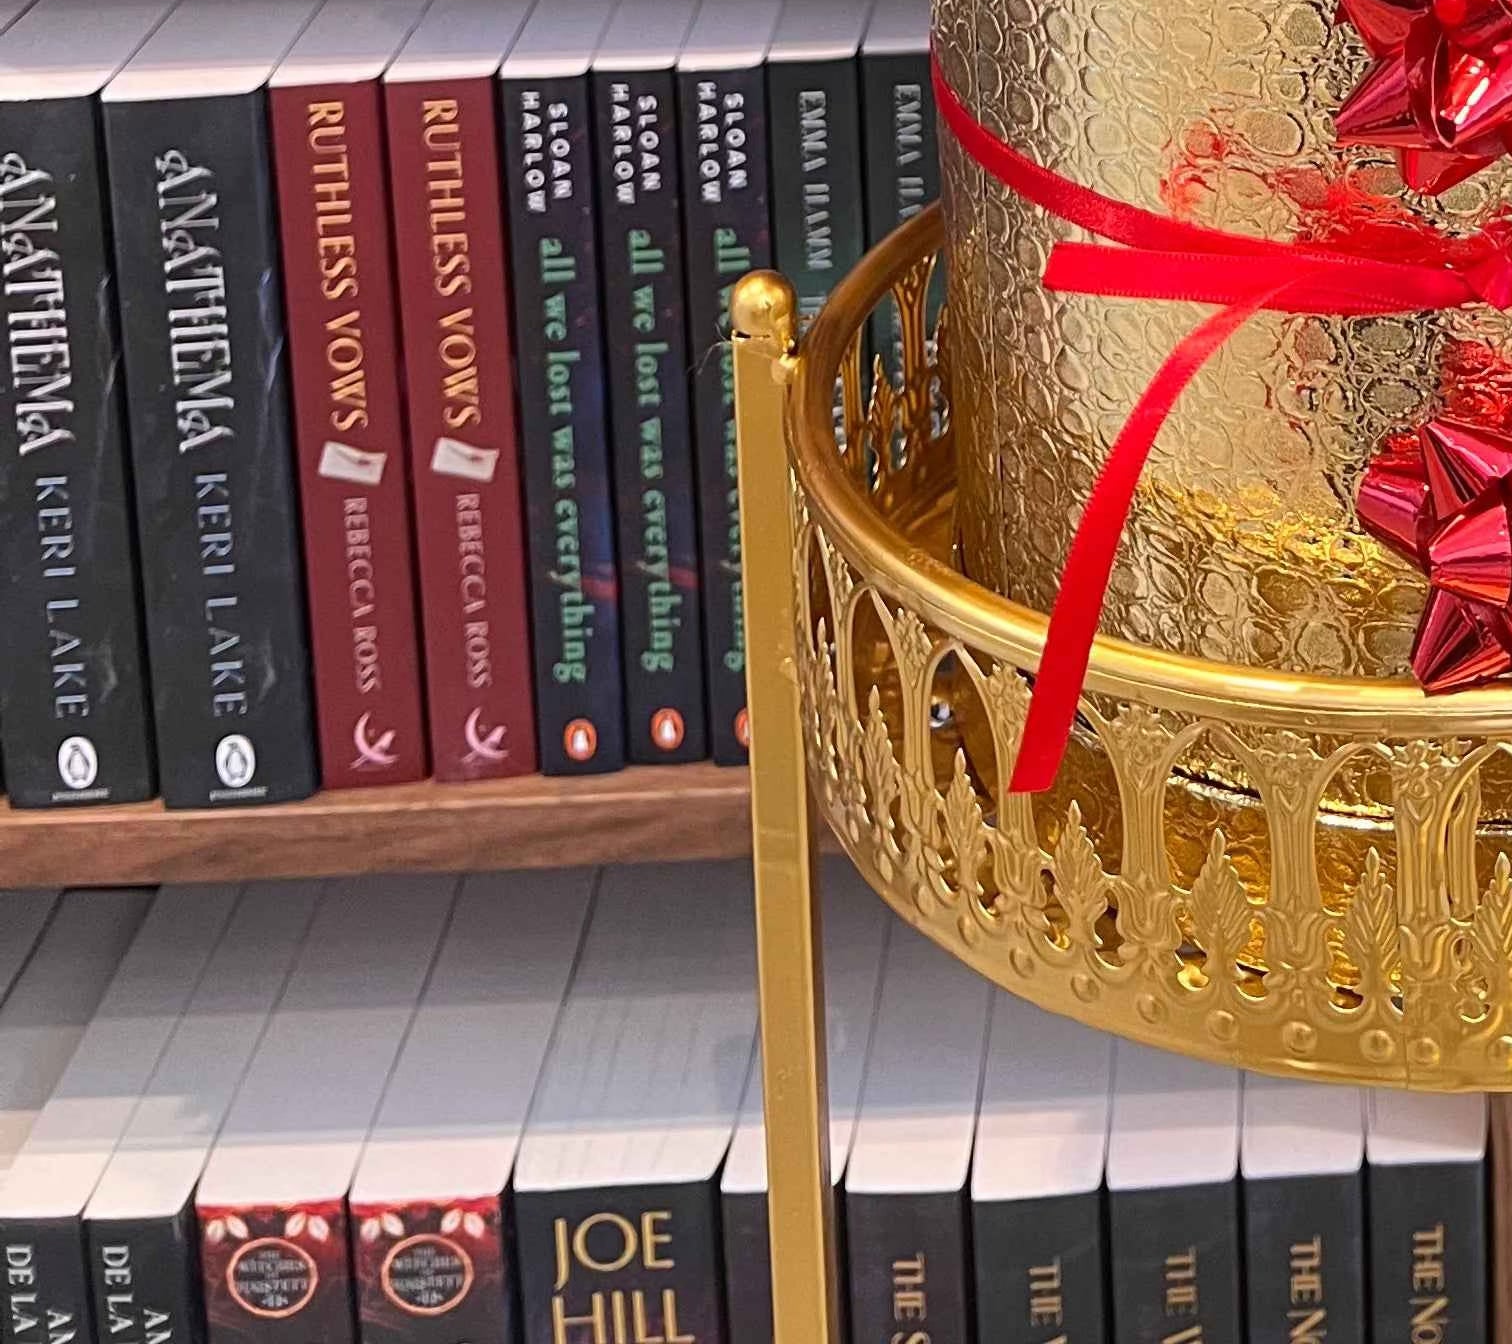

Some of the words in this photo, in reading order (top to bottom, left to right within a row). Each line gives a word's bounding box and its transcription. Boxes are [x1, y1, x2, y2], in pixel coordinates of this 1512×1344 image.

[521, 91, 546, 213] HARLOW
[547, 102, 573, 200] SLOAN
[610, 83, 635, 204] HARLOW
[637, 95, 662, 192] SLOAN
[697, 81, 722, 202] HARLOW
[723, 92, 748, 190] SLOAN
[800, 90, 828, 172] EMMA
[894, 84, 923, 166] EMMA
[307, 100, 359, 301] RUTHLESS
[422, 99, 472, 297] RUTHLESS
[804, 183, 832, 270] HAMM
[539, 237, 576, 283] all
[628, 229, 664, 274] all
[713, 228, 750, 274] all
[0, 152, 77, 456] ANATHEMA
[155, 149, 235, 454] ANATHEMA
[544, 291, 567, 342] we
[632, 285, 655, 334] we
[325, 310, 369, 432] VOWS
[438, 307, 482, 430] VOWS
[548, 350, 581, 416] lost
[635, 342, 669, 407] lost
[551, 425, 576, 489] was
[639, 417, 663, 480] was
[35, 475, 77, 577] KERI
[195, 473, 235, 575] KERI
[344, 497, 375, 619] REBECCA
[456, 493, 486, 614] REBECCA
[548, 498, 595, 684] everything
[636, 489, 683, 673] everything
[46, 599, 90, 718] LAKE
[206, 596, 248, 717] LAKE
[352, 625, 381, 695] ROSS
[464, 621, 493, 689] ROSS
[5, 1244, 36, 1286] DE
[102, 1245, 131, 1286] DE
[553, 1211, 676, 1291] JOE
[892, 1251, 928, 1322] THE
[1028, 1256, 1064, 1327] THE
[1164, 1245, 1200, 1311] THE
[1288, 1233, 1324, 1308] THE
[1411, 1223, 1447, 1291] THE
[10, 1293, 39, 1335] LA
[107, 1293, 134, 1334] LA
[552, 1288, 697, 1344] HILL
